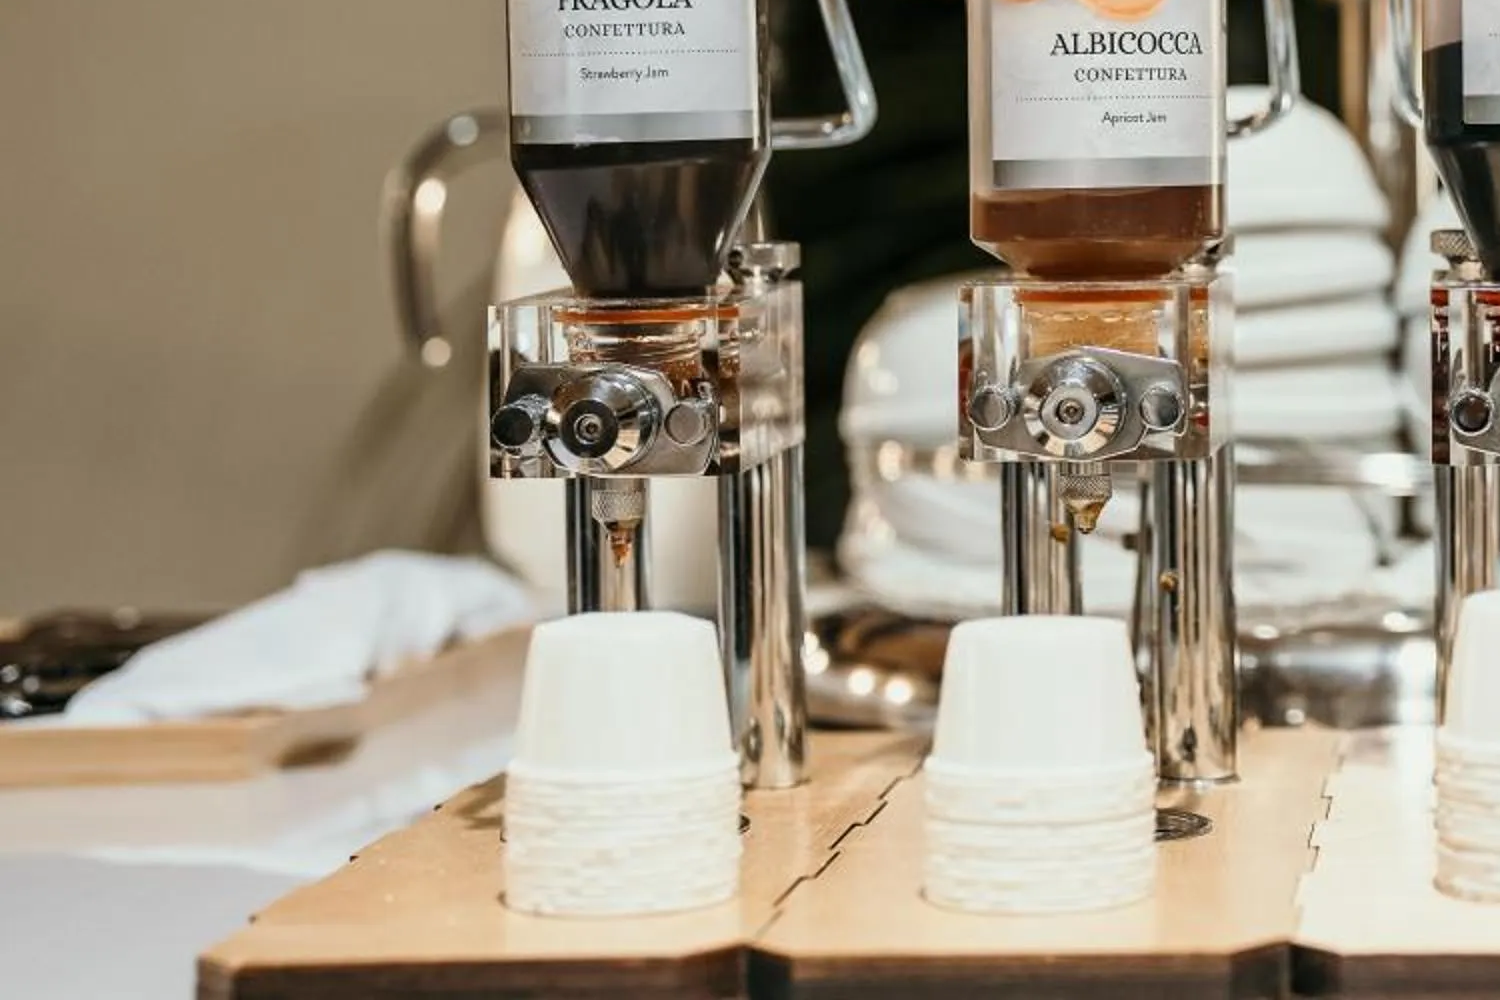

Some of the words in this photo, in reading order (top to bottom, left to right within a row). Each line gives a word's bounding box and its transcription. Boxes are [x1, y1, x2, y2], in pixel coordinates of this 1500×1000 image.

[564, 22, 686, 39] CONFETTURA
[1049, 30, 1203, 56] ALBICOCCA
[579, 66, 643, 82] Strawberry
[1074, 67, 1188, 82] CONFETTURA
[1101, 110, 1145, 126] Apricot
